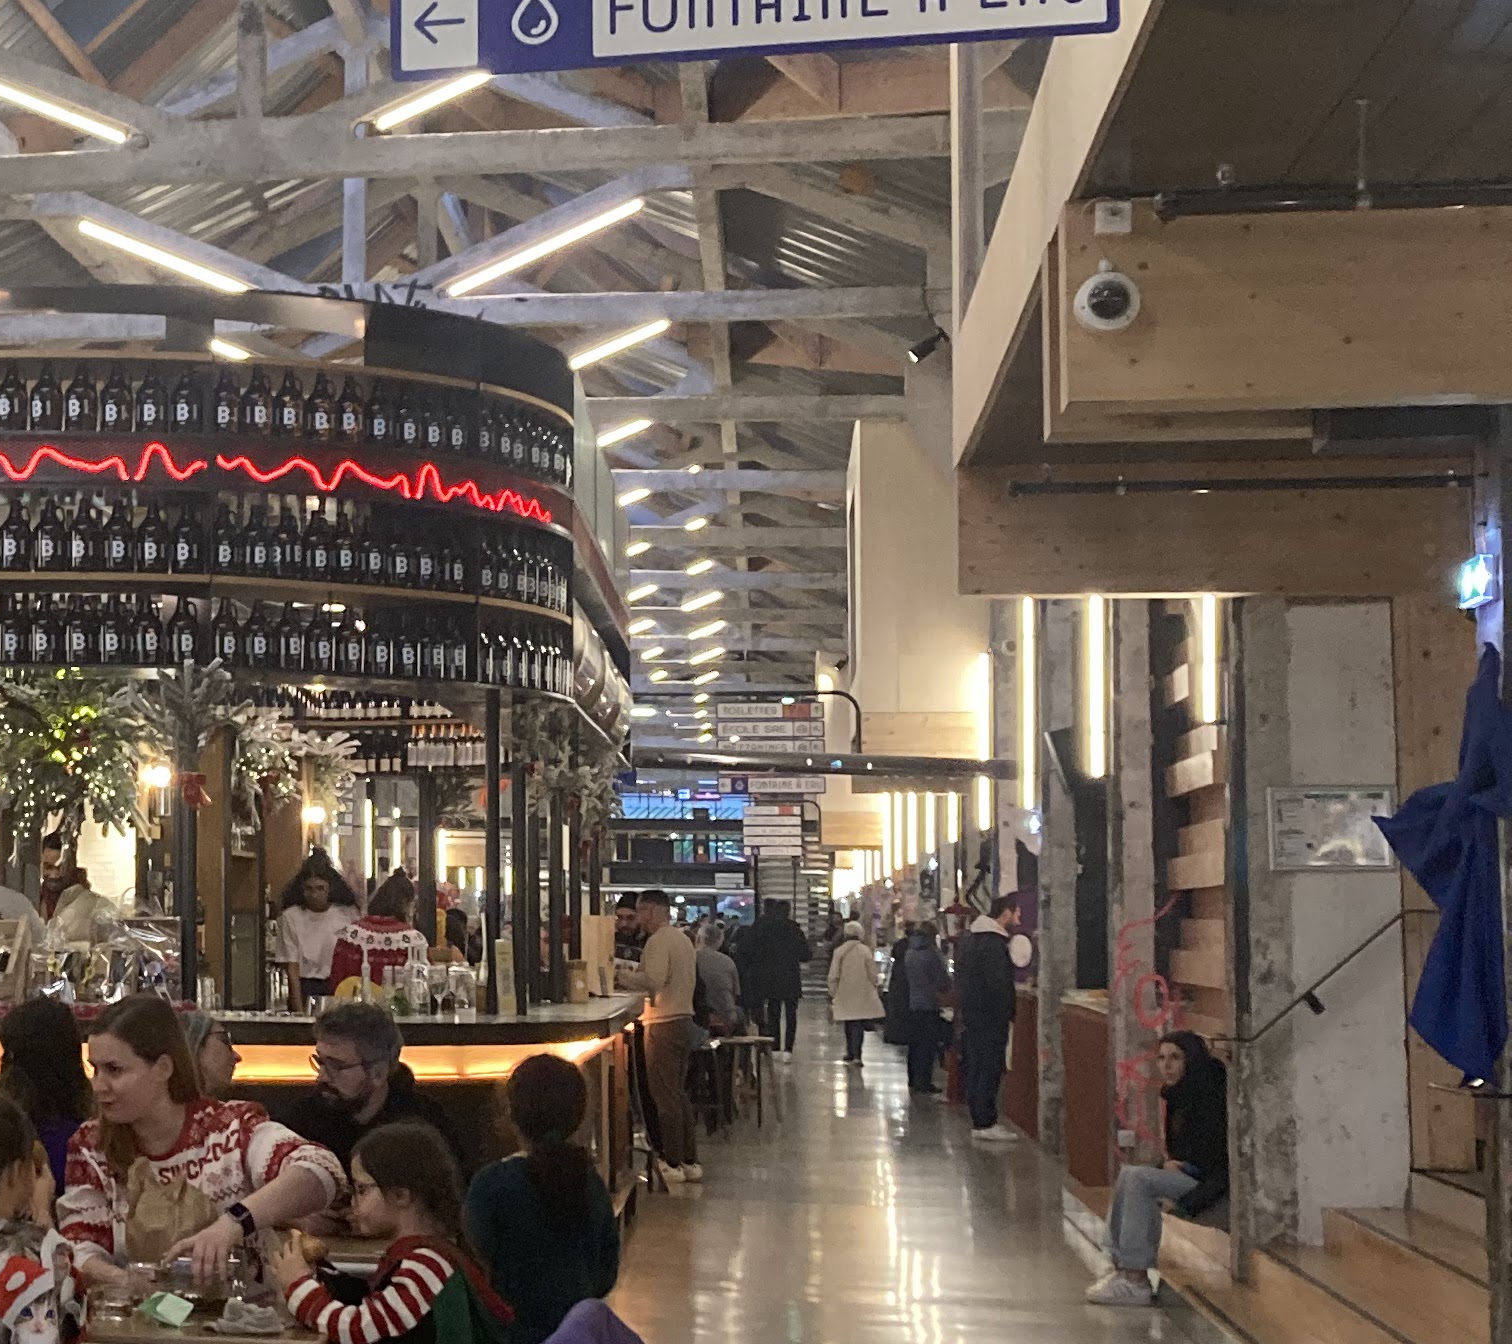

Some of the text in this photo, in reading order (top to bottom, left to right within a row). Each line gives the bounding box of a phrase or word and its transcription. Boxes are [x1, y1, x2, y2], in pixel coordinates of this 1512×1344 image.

[0, 397, 10, 416] B
[32, 399, 43, 417] B
[69, 399, 80, 416] B
[105, 404, 117, 422] B
[144, 404, 156, 422] B
[177, 404, 189, 421] B
[218, 406, 230, 424] B
[255, 406, 266, 423] B
[284, 408, 296, 425] B
[316, 412, 328, 430] B
[343, 413, 355, 430] B
[374, 418, 385, 436] B
[404, 423, 416, 440] B
[428, 426, 439, 443] B
[452, 429, 463, 446] B
[4, 539, 16, 556] B
[42, 539, 54, 556] B
[73, 540, 85, 557] B
[113, 540, 125, 557] B
[145, 542, 157, 559] B
[177, 543, 189, 560] B
[219, 545, 231, 562] B
[254, 546, 266, 564] B
[316, 550, 327, 567] B
[341, 550, 352, 567] B
[370, 552, 381, 570] B
[396, 556, 407, 574] B
[421, 558, 432, 575] B
[454, 563, 463, 580] B
[5, 633, 18, 651] B
[35, 633, 48, 651] B
[73, 633, 85, 650] B
[106, 633, 118, 651] B
[146, 633, 158, 650] B
[181, 634, 193, 651] B
[224, 637, 236, 654] B
[254, 637, 266, 654] B
[290, 637, 300, 654] B
[319, 641, 330, 658] B
[348, 643, 360, 660] B
[376, 646, 388, 662] B
[402, 647, 414, 664] B
[433, 648, 442, 664] B
[455, 649, 463, 665] B
